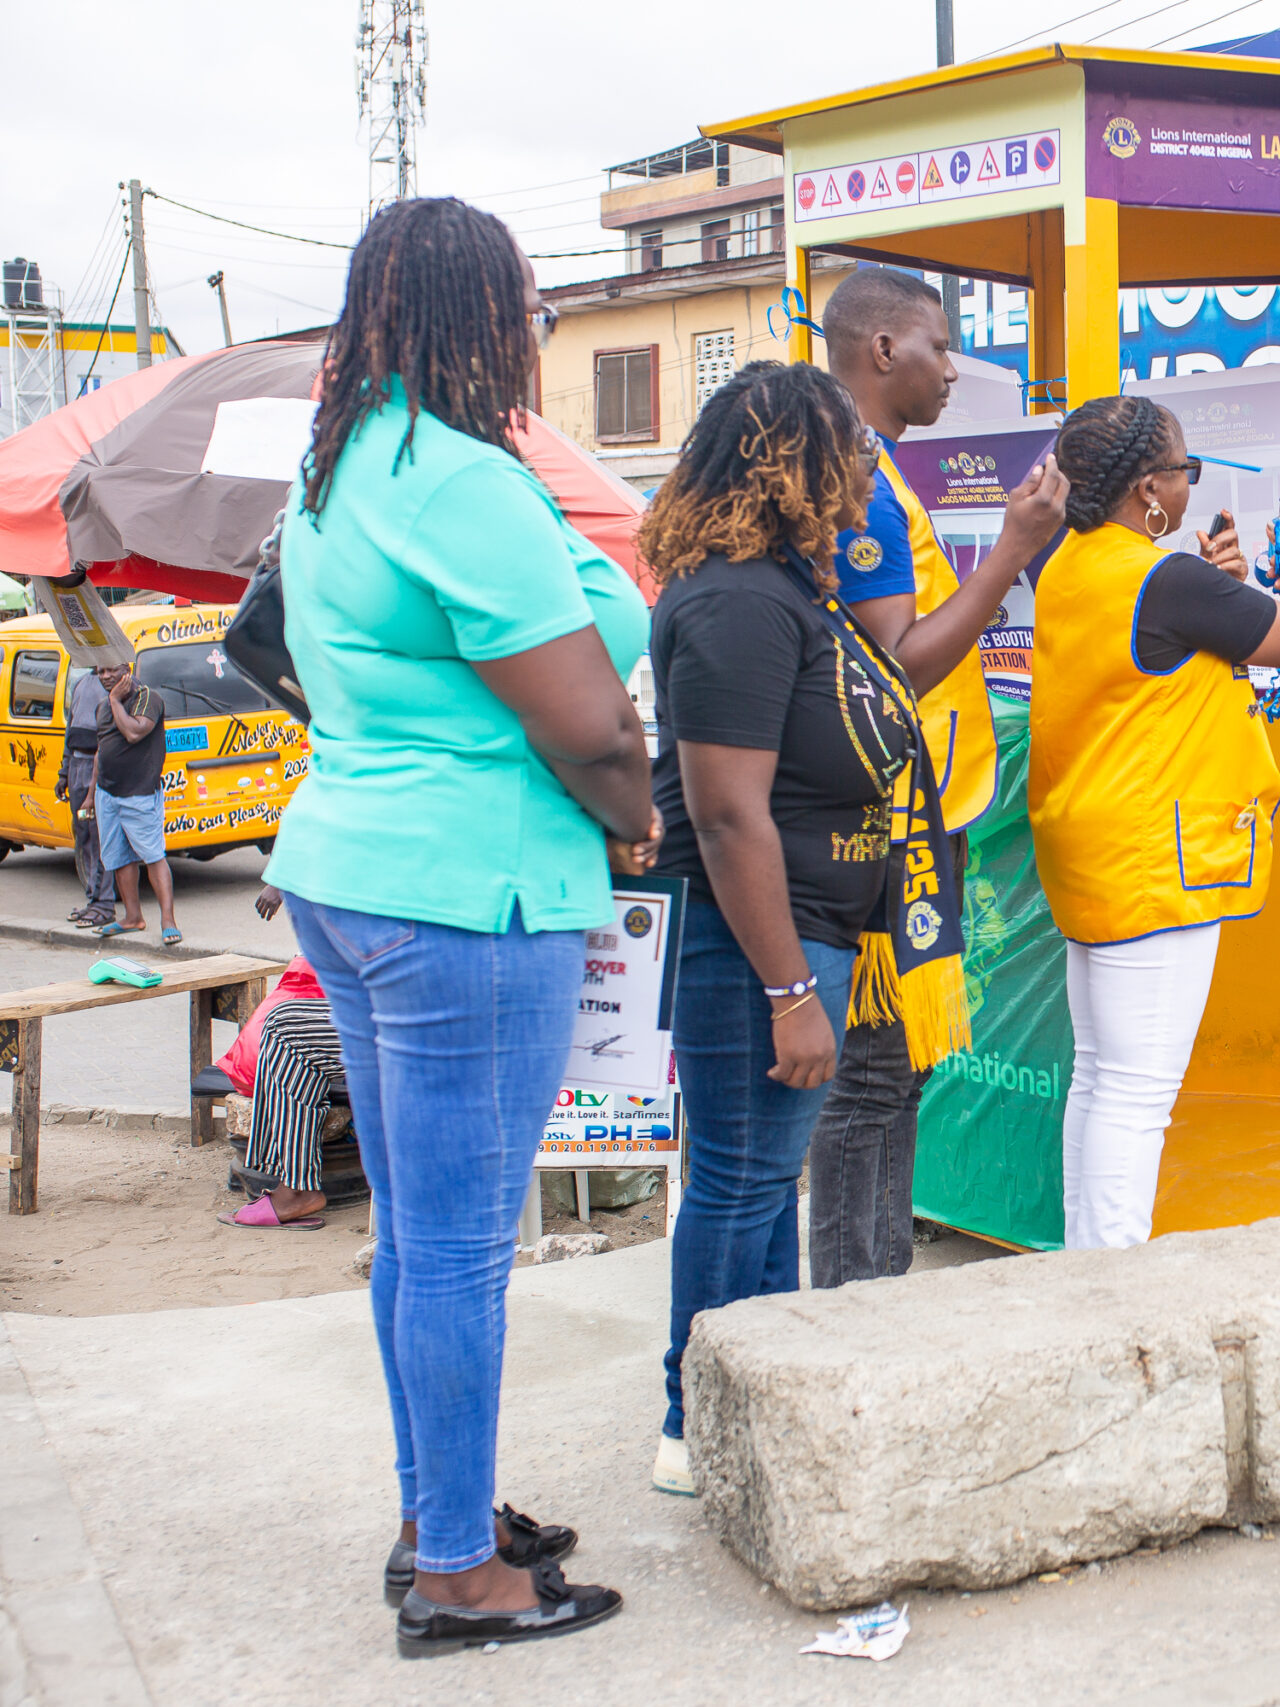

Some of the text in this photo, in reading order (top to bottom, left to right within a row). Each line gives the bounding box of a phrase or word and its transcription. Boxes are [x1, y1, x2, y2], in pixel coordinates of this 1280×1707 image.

[1151, 127, 1252, 146] Lions International
[1150, 142, 1189, 156] DISTRICT
[1216, 146, 1253, 159] NIGERIA
[799, 188, 815, 200] STOP
[946, 475, 1000, 487] Lions International
[936, 494, 959, 504] LAGOS
[959, 493, 985, 503] MARVEL
[984, 493, 1003, 502] LIONS
[991, 630, 1034, 648] BOOTH
[232, 720, 271, 753] Never
[164, 814, 194, 834] who
[568, 1110, 576, 1119] it.
[578, 1110, 598, 1119] Love
[600, 1110, 609, 1119] it.
[613, 1110, 670, 1120] StarTimes
